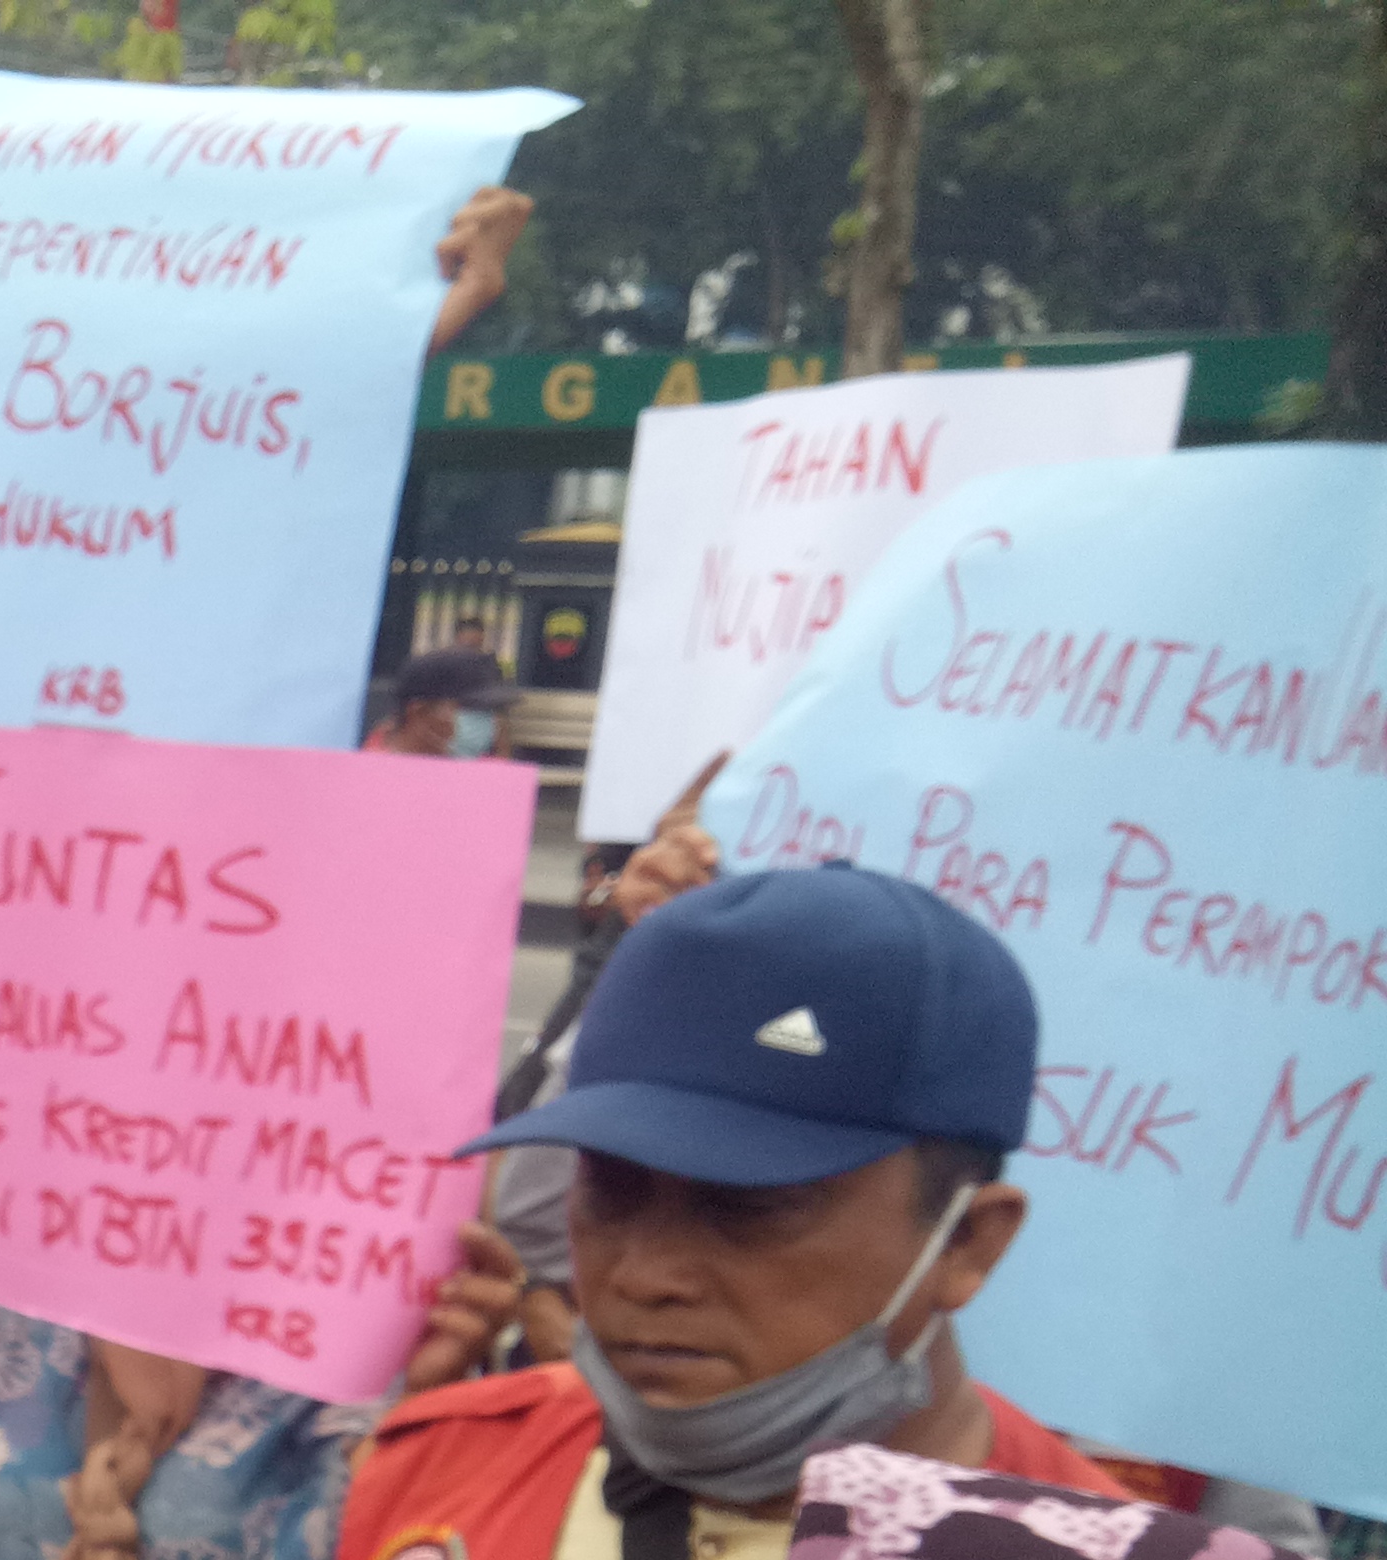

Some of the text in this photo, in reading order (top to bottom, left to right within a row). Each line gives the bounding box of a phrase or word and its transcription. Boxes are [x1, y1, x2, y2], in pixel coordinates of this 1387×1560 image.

[146, 112, 407, 180] HUKUM
[736, 413, 947, 513] TAHAN
[901, 783, 1051, 931] PARA
[155, 976, 375, 1111] ANAM
[40, 1080, 233, 1178] KREDIT
[239, 1110, 477, 1221] MACET
